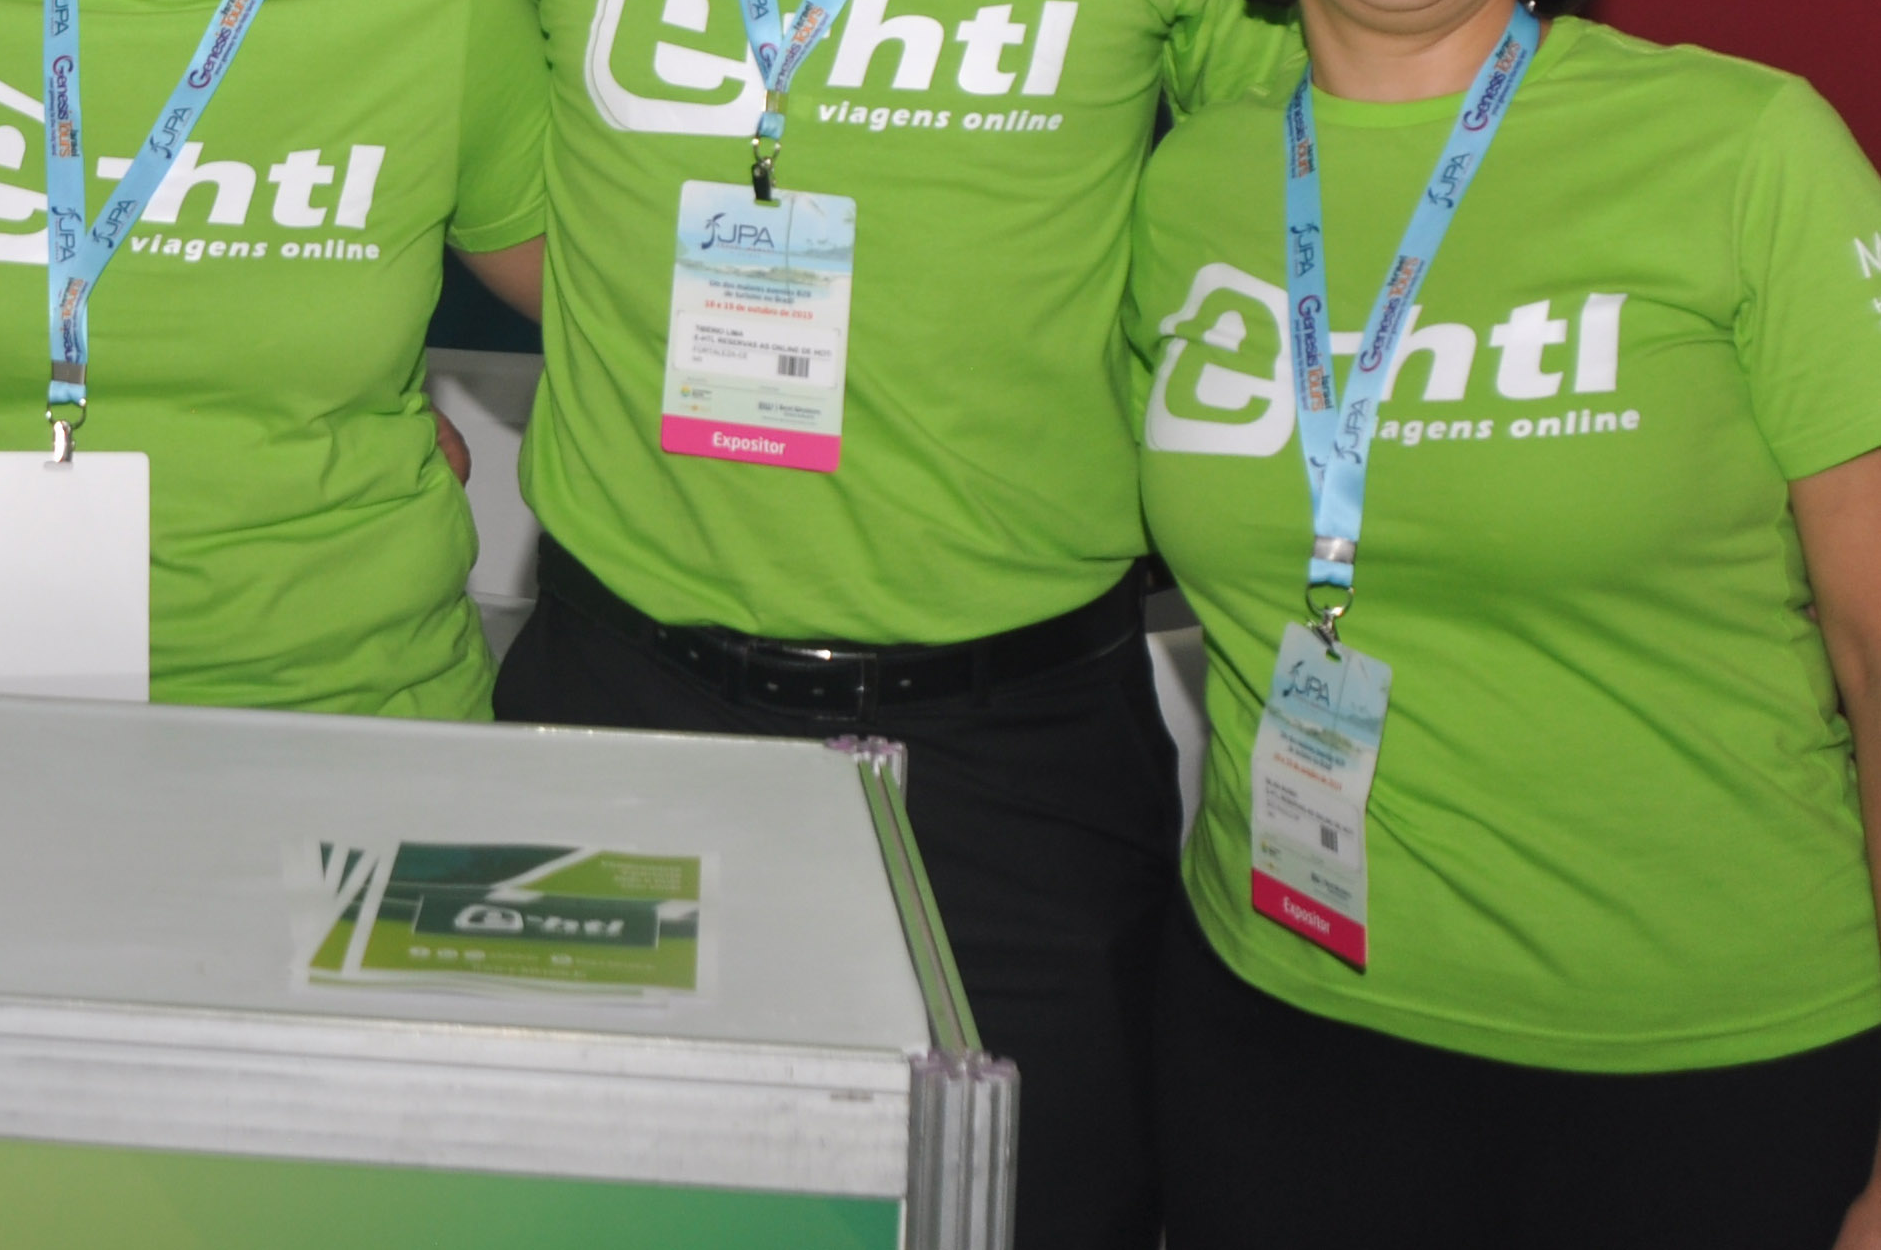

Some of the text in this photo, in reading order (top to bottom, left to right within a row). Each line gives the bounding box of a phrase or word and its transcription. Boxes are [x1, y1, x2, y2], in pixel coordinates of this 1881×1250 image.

[188, 27, 233, 89] Genesis
[52, 55, 74, 120] Genesis
[1462, 71, 1508, 131] Genesis
[818, 101, 1064, 132] viagens online
[130, 234, 381, 262] viagens online
[717, 223, 775, 249] JPA
[1298, 294, 1323, 367] Genesis
[1358, 297, 1401, 372] Genesis
[711, 431, 786, 456] Expositor
[1370, 408, 1641, 446] iagens online
